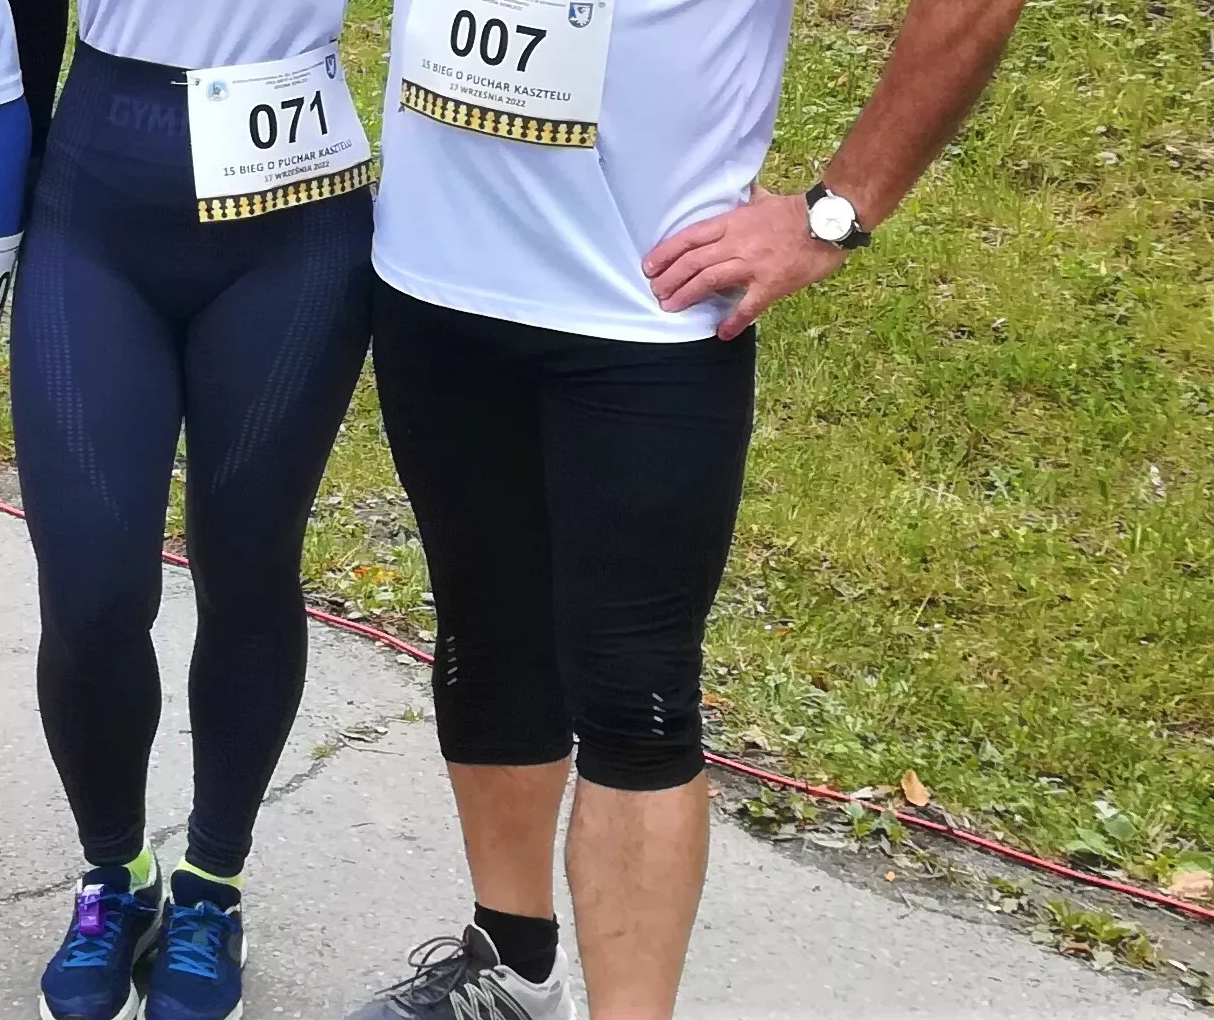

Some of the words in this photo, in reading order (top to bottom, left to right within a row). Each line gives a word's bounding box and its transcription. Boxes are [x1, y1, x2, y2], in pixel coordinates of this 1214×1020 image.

[450, 9, 547, 72] 007
[421, 58, 431, 69] 15
[432, 62, 453, 78] BIEG
[455, 70, 464, 80] O
[466, 73, 510, 93] PUCHAR
[514, 84, 572, 102] KASZTELU
[449, 82, 459, 92] 17
[460, 84, 504, 103] WRZEŚNIA
[505, 96, 527, 108] 2022
[249, 90, 328, 150] 071
[223, 166, 236, 176] 15
[239, 163, 264, 175] BIEG
[267, 161, 275, 170] O
[278, 151, 316, 168] PUCHAR
[318, 139, 353, 158] KASZTELU
[313, 160, 330, 171] 2022
